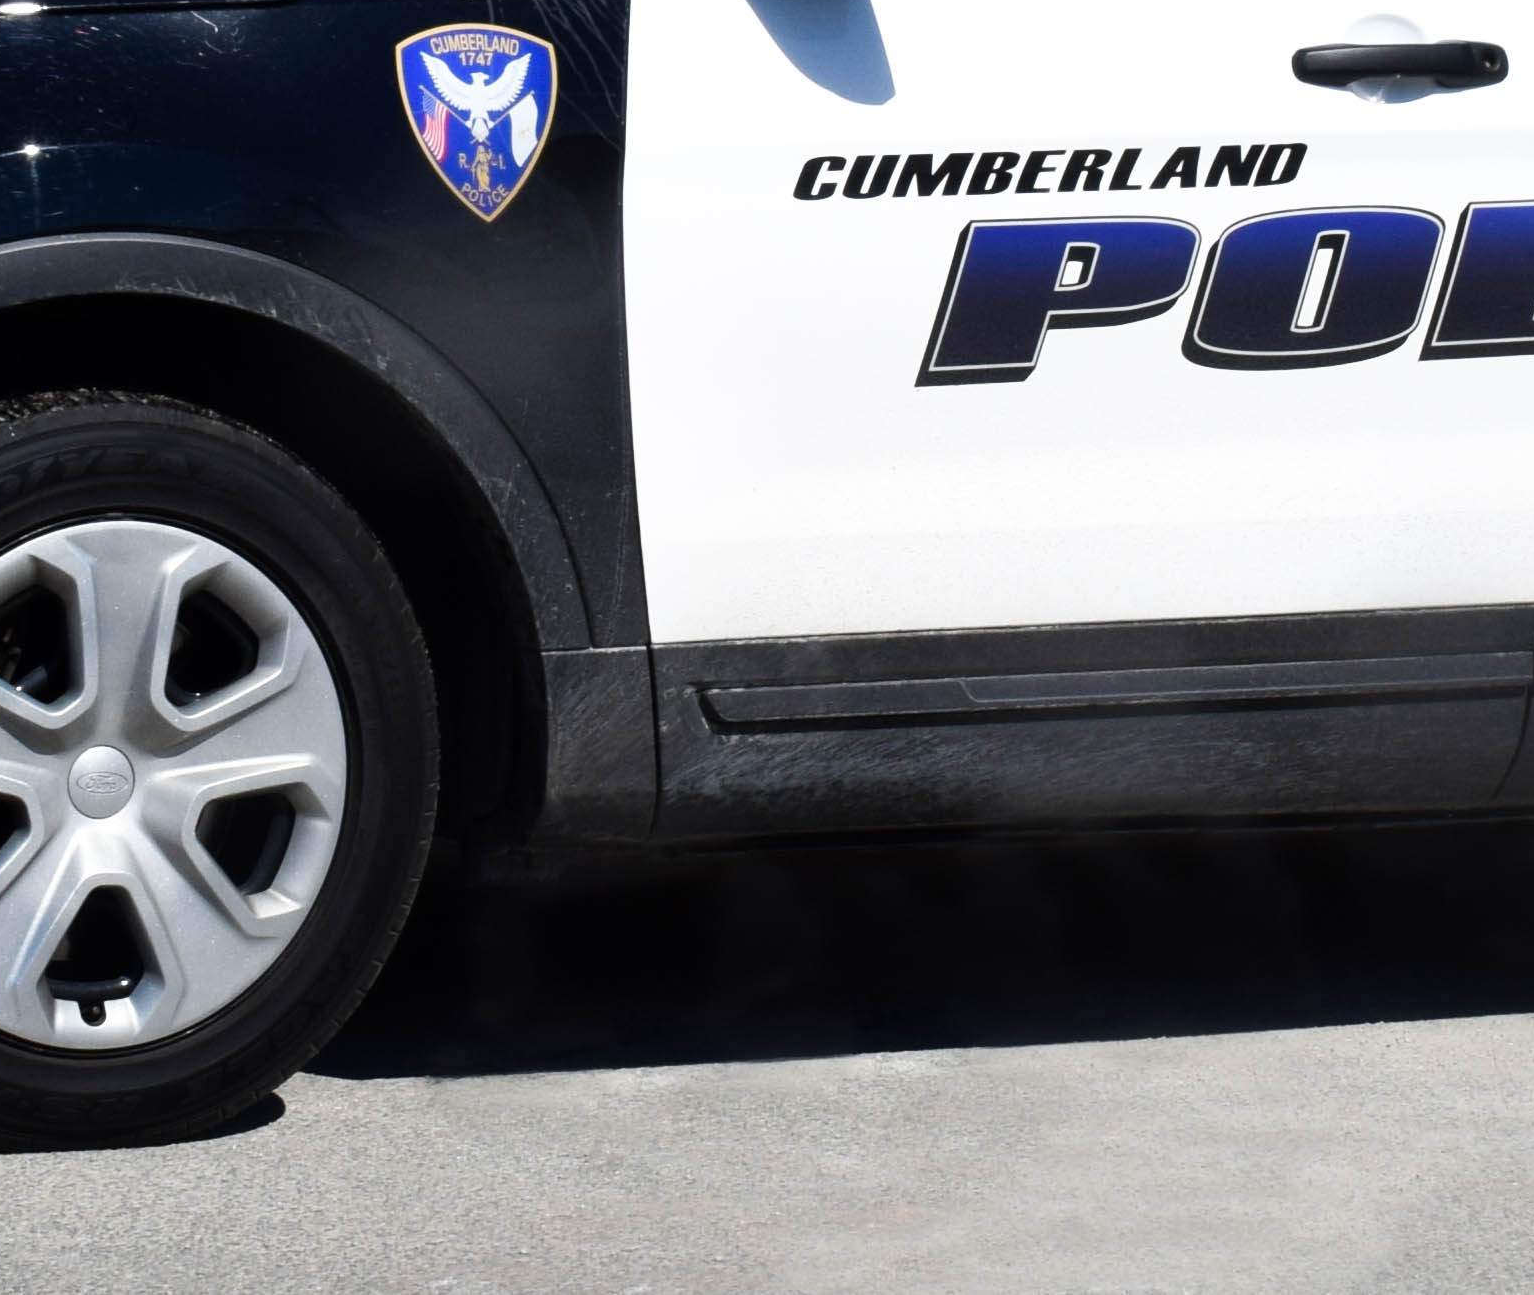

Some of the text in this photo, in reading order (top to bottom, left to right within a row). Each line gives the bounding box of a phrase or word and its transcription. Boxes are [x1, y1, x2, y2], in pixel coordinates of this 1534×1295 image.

[429, 33, 520, 56] CUMBERLAND
[458, 52, 494, 67] 1747
[793, 142, 1309, 201] CUMBERLAND
[461, 182, 510, 207] POLICE
